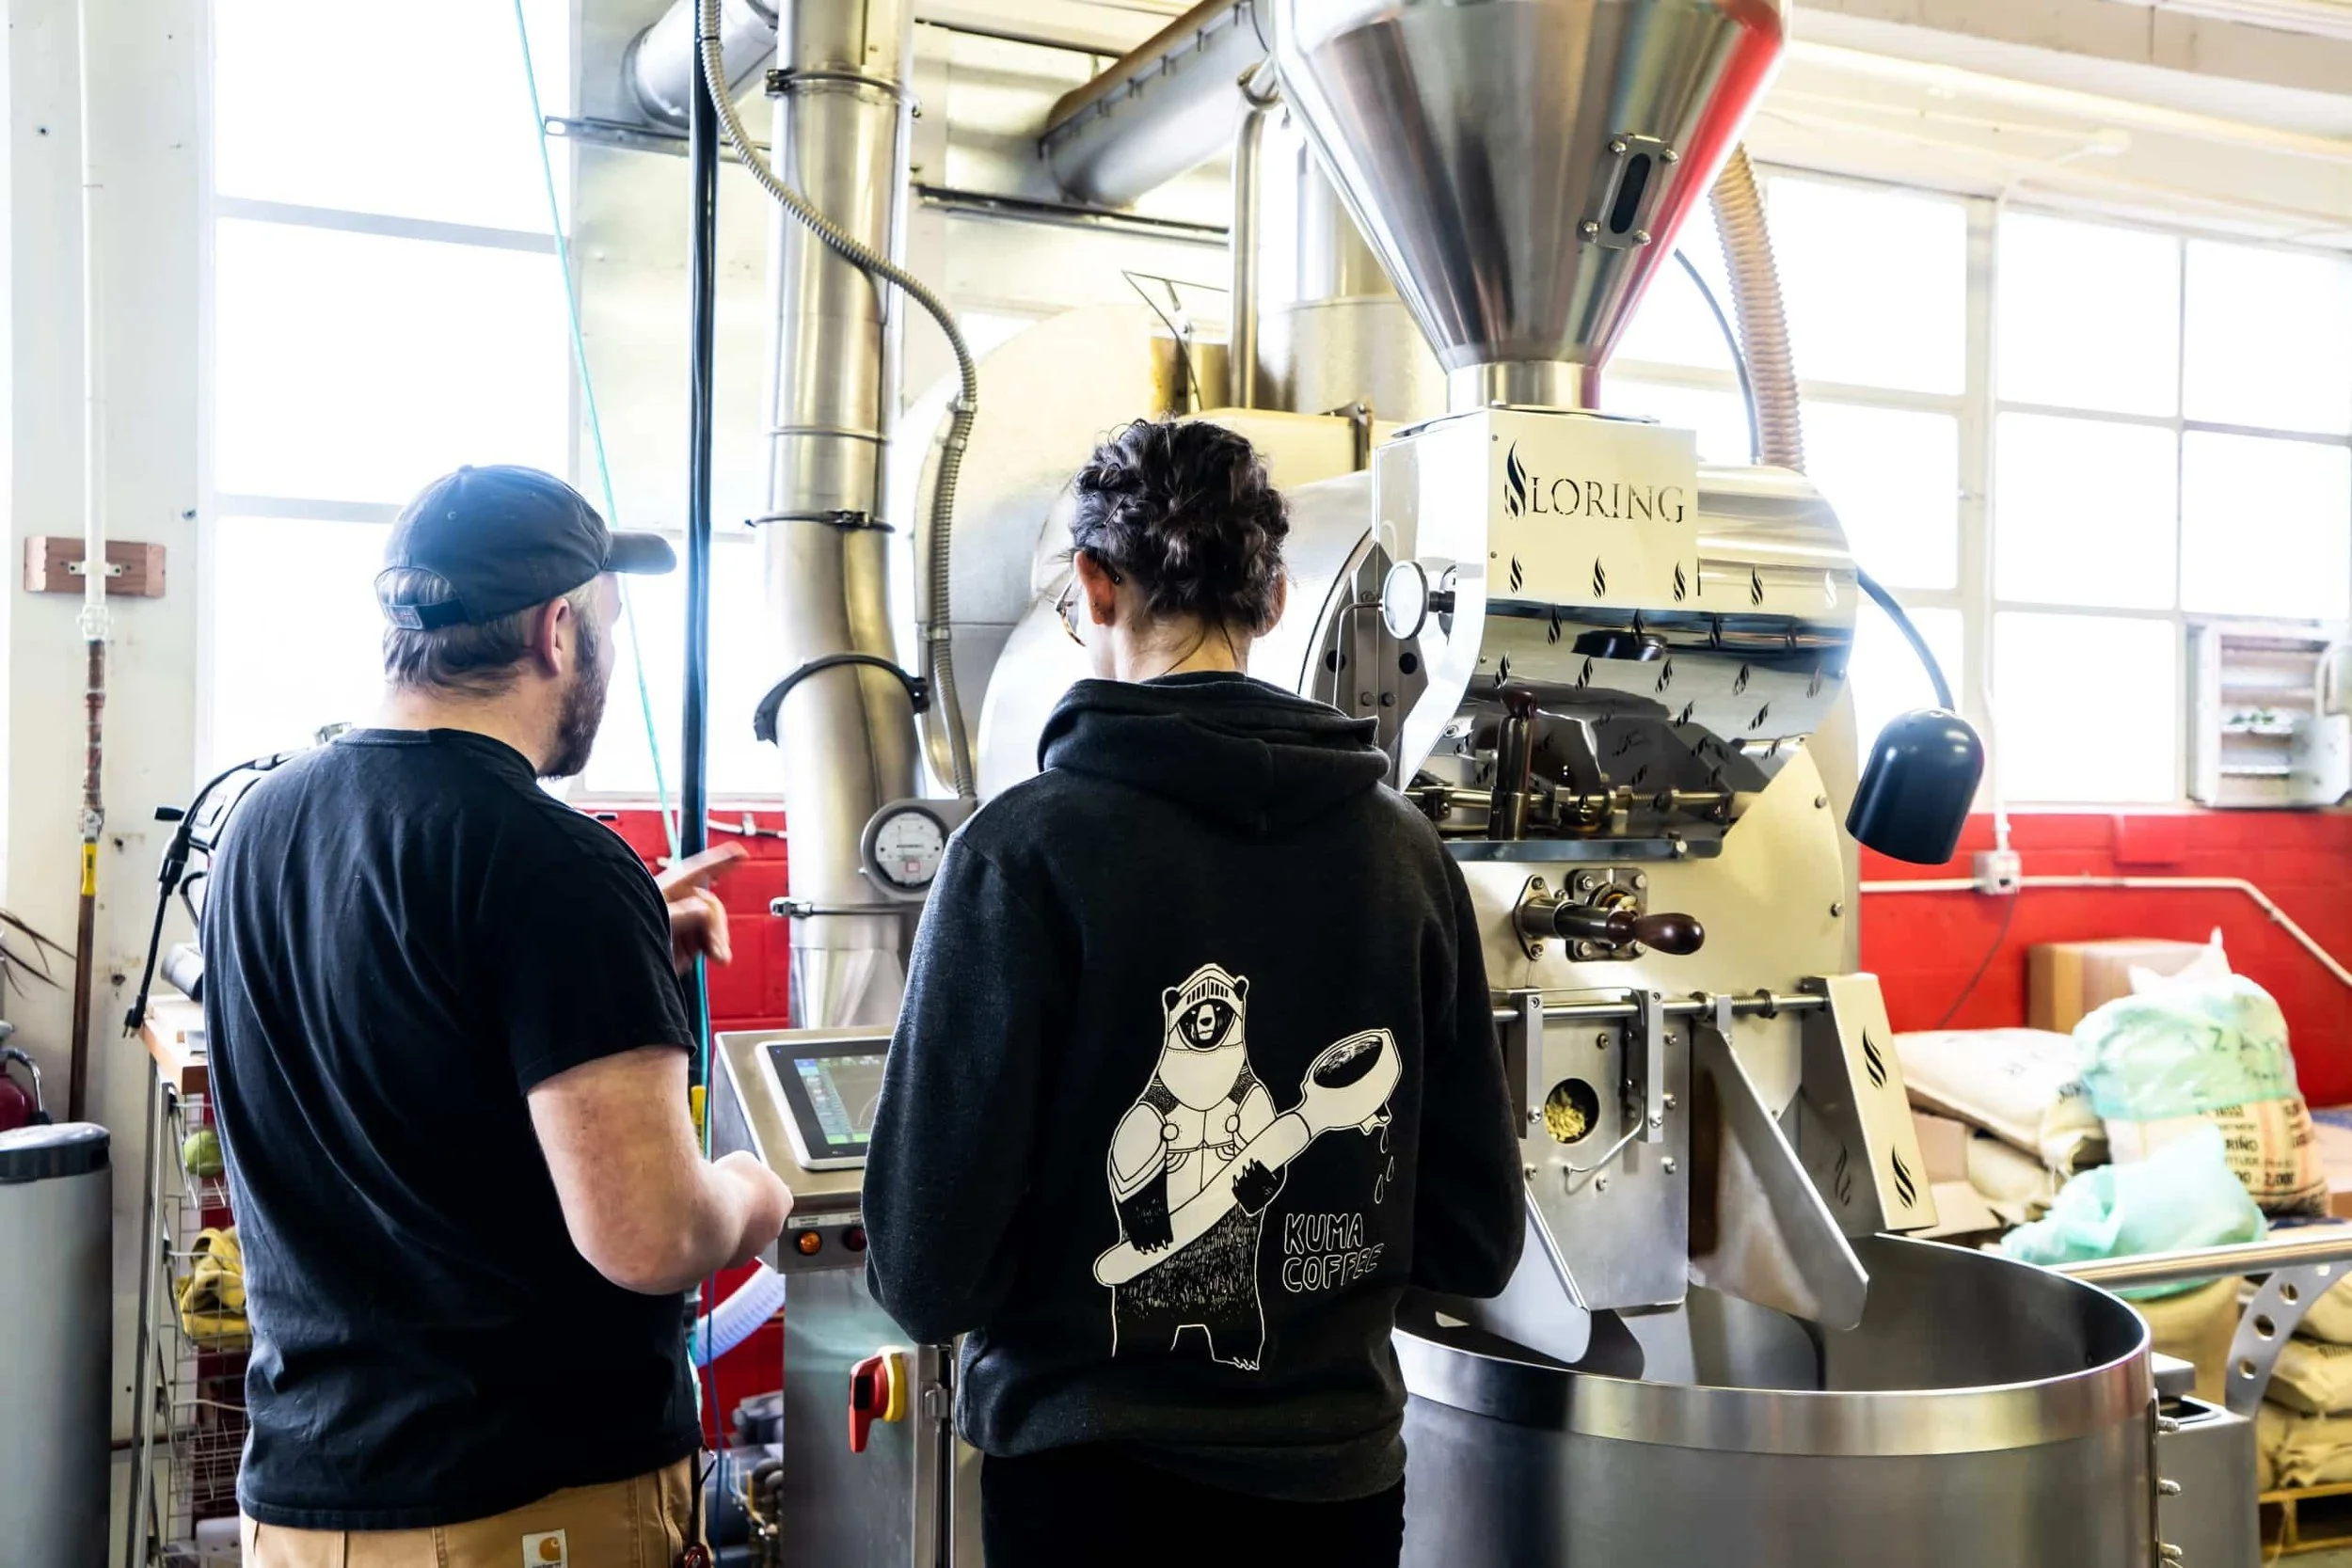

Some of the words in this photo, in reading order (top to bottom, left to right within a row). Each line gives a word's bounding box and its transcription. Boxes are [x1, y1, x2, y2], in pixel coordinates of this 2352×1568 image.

[1530, 477, 1687, 524] LORING
[1284, 1212, 1364, 1255] KUMA
[1282, 1243, 1385, 1293] COFFEE
